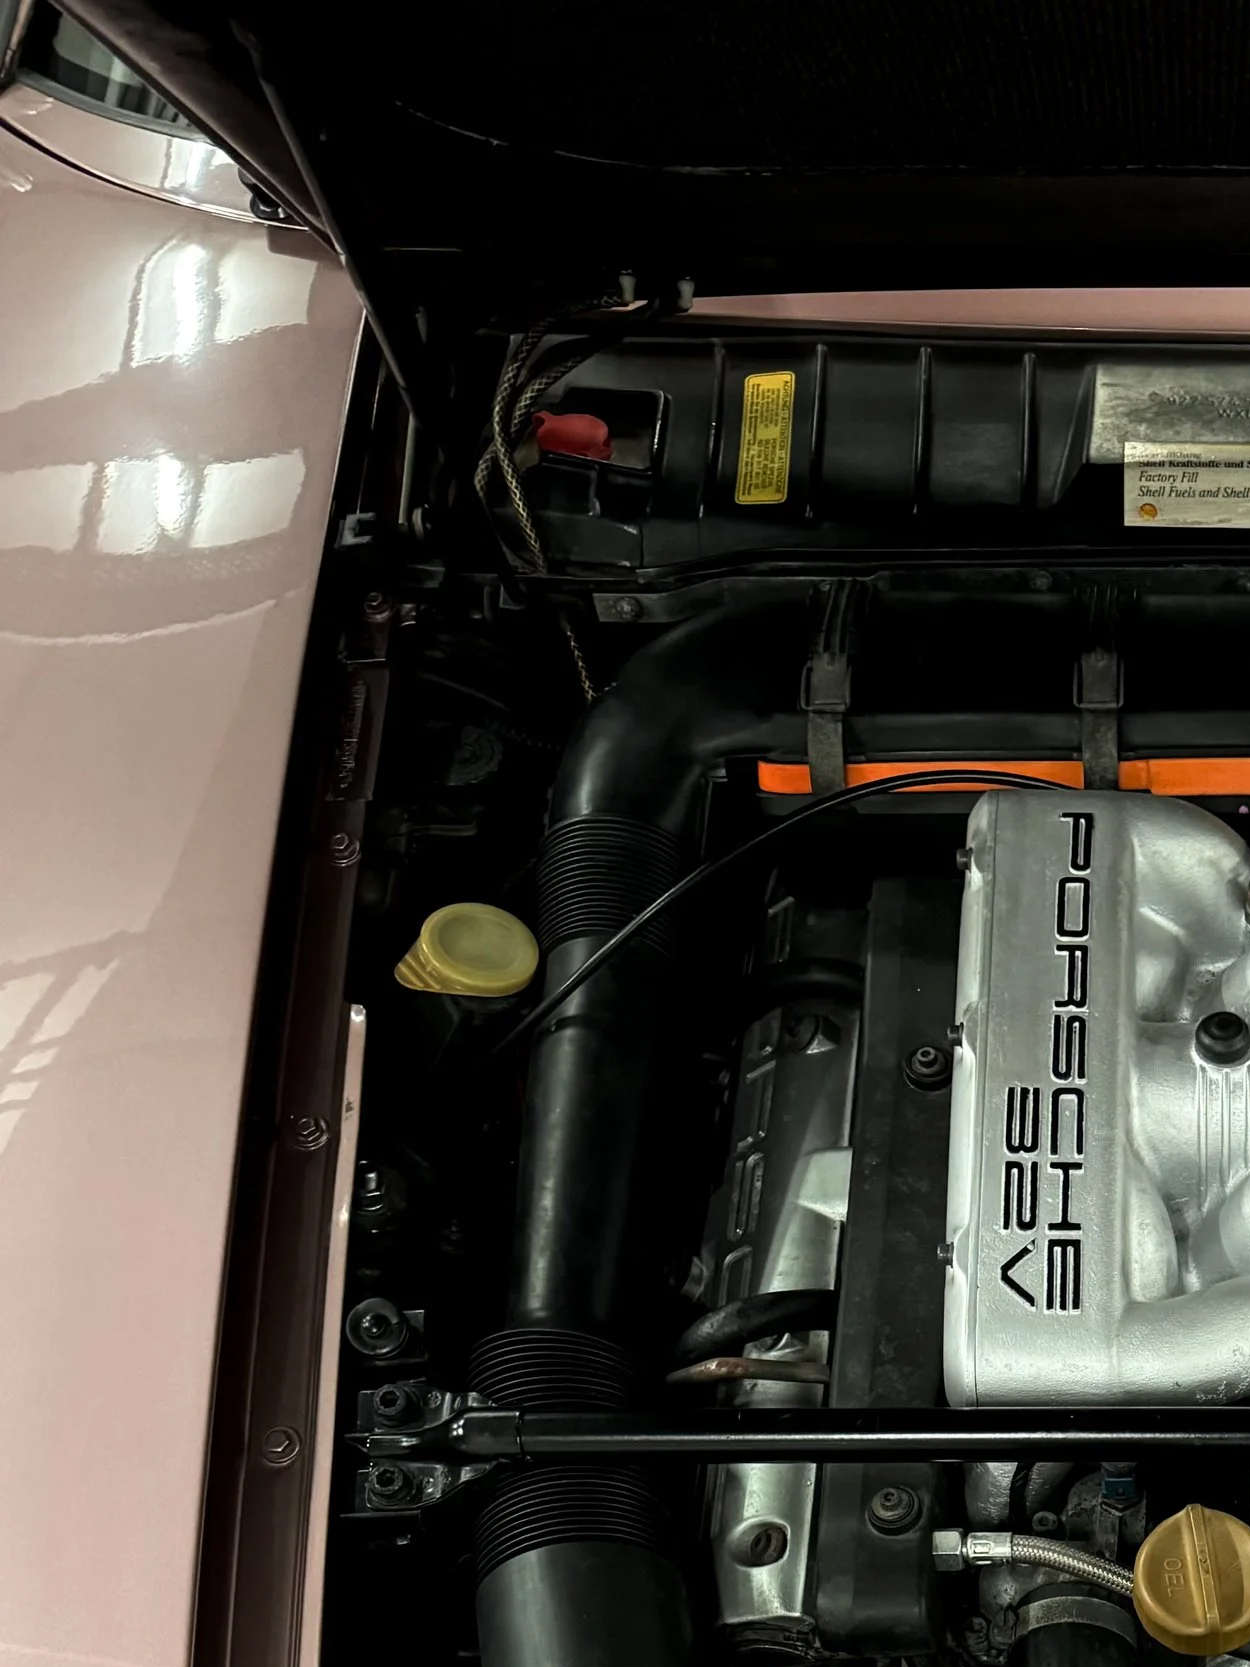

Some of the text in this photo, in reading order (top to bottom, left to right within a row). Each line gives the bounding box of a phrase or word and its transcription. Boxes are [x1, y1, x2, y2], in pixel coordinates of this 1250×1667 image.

[1138, 471, 1199, 485] Factory Fill
[1139, 460, 1165, 468] Shell
[1168, 460, 1222, 468] Kraftstoffe
[1224, 460, 1244, 469] und
[1137, 485, 1166, 498] Shell
[1167, 486, 1196, 498] Fuels
[1198, 487, 1220, 498] and
[1222, 487, 1250, 499] Shell
[1044, 812, 1095, 1314] PORSCHE
[1000, 1086, 1041, 1310] 32V
[1163, 1557, 1185, 1597] OEL
